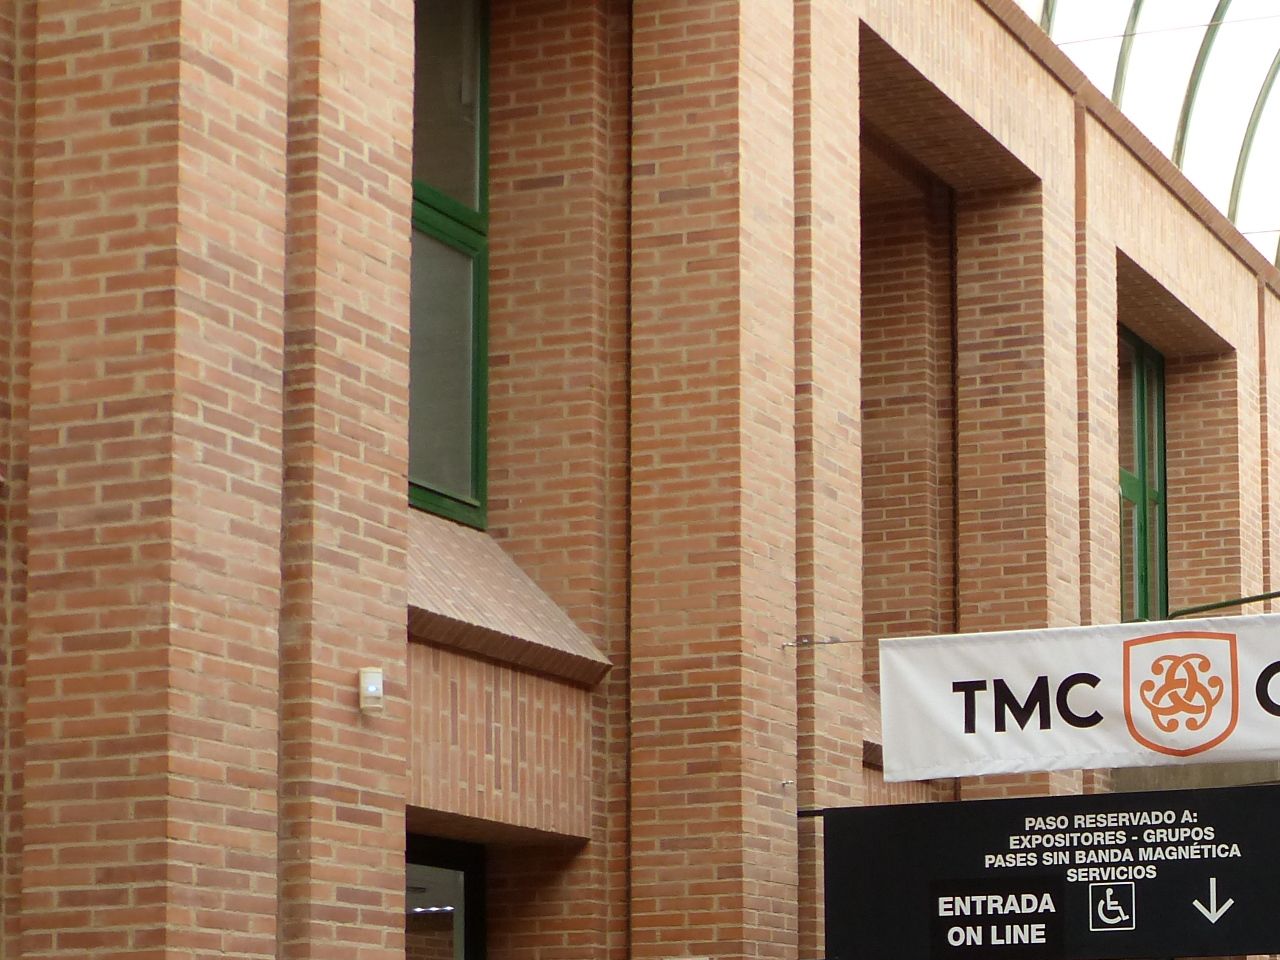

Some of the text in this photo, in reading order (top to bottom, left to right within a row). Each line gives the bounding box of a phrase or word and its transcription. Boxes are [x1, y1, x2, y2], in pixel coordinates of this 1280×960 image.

[953, 673, 1103, 733] TMC
[1026, 810, 1197, 830] PASO RESERVADO A:
[1009, 831, 1127, 849] EXPOSITORES
[1143, 827, 1215, 843] GRUPOS
[985, 842, 1241, 868] PASES SIN BANDA MAGNÉTICA
[1067, 865, 1156, 883] SERVICIOS
[939, 894, 1055, 916] ENTRADA
[948, 924, 1045, 946] ON LINE
